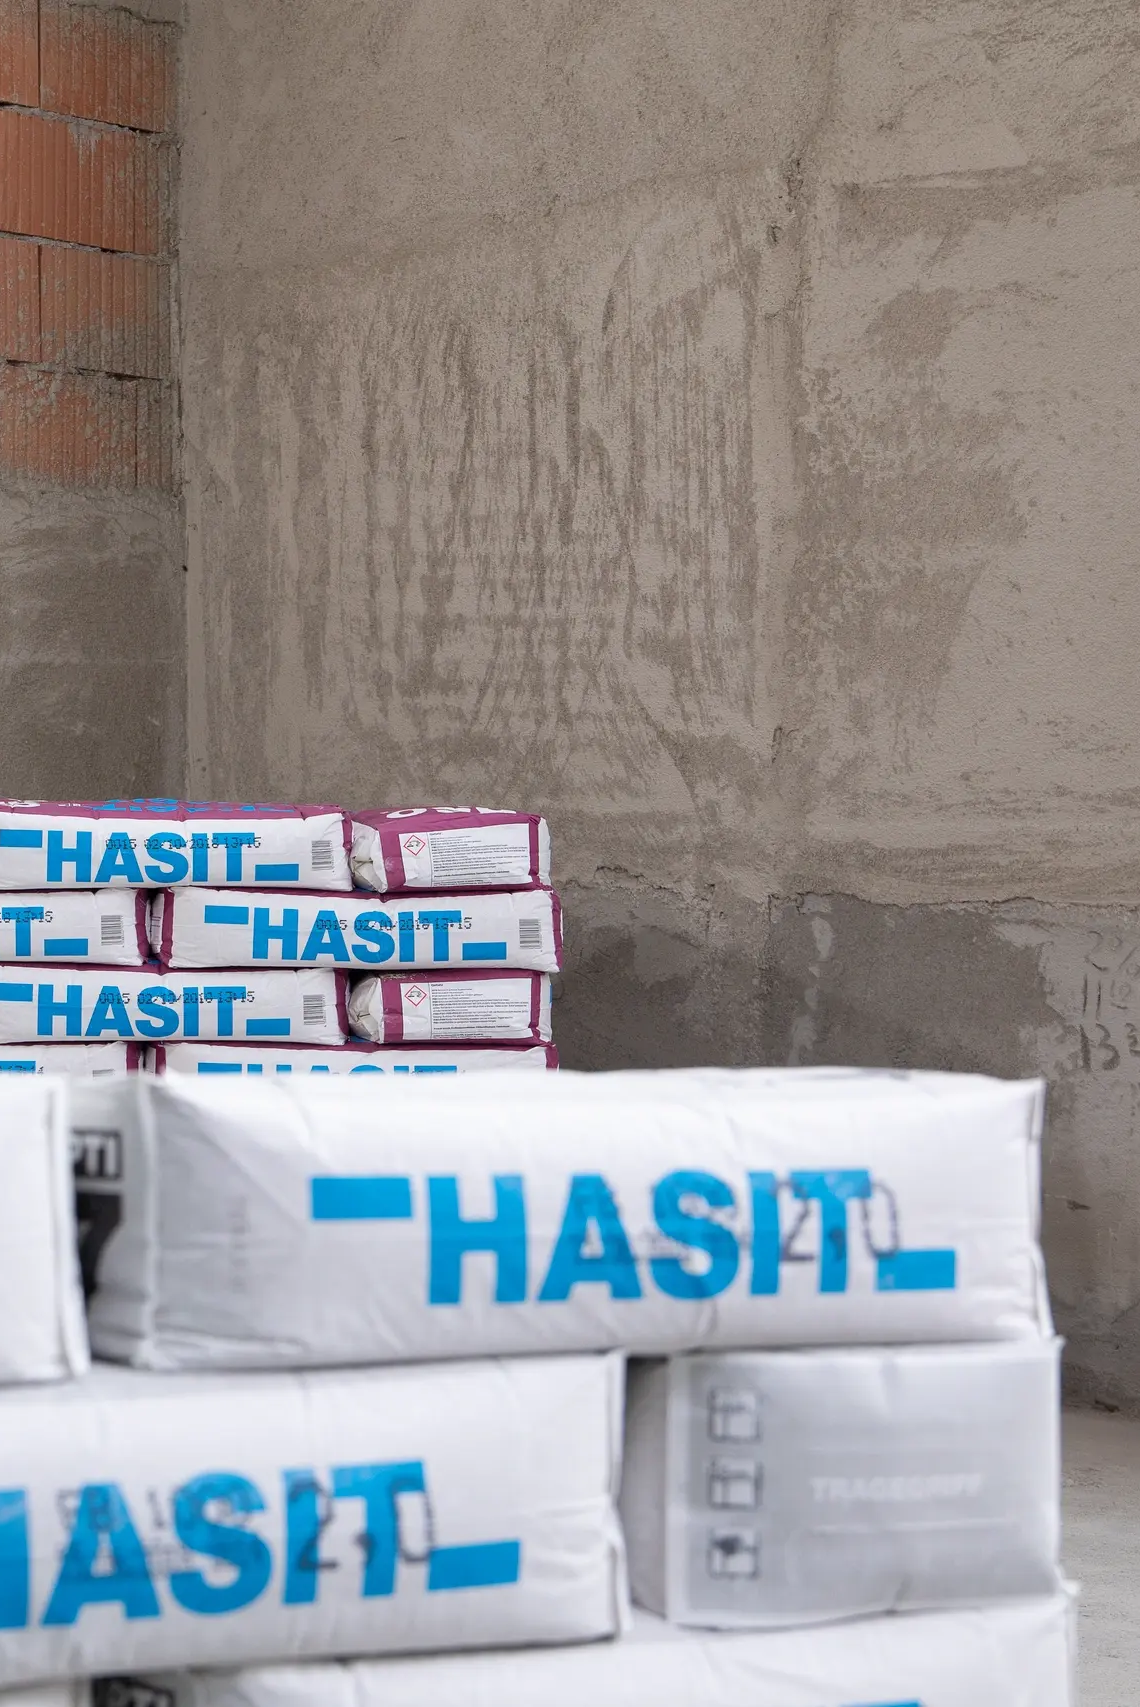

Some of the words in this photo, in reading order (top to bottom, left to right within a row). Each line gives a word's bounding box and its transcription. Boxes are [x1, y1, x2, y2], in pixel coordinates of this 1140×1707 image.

[47, 830, 256, 883] HASIT
[253, 908, 462, 963] HASIT
[37, 984, 247, 1037] HASIT
[428, 1169, 872, 1305] HASIT
